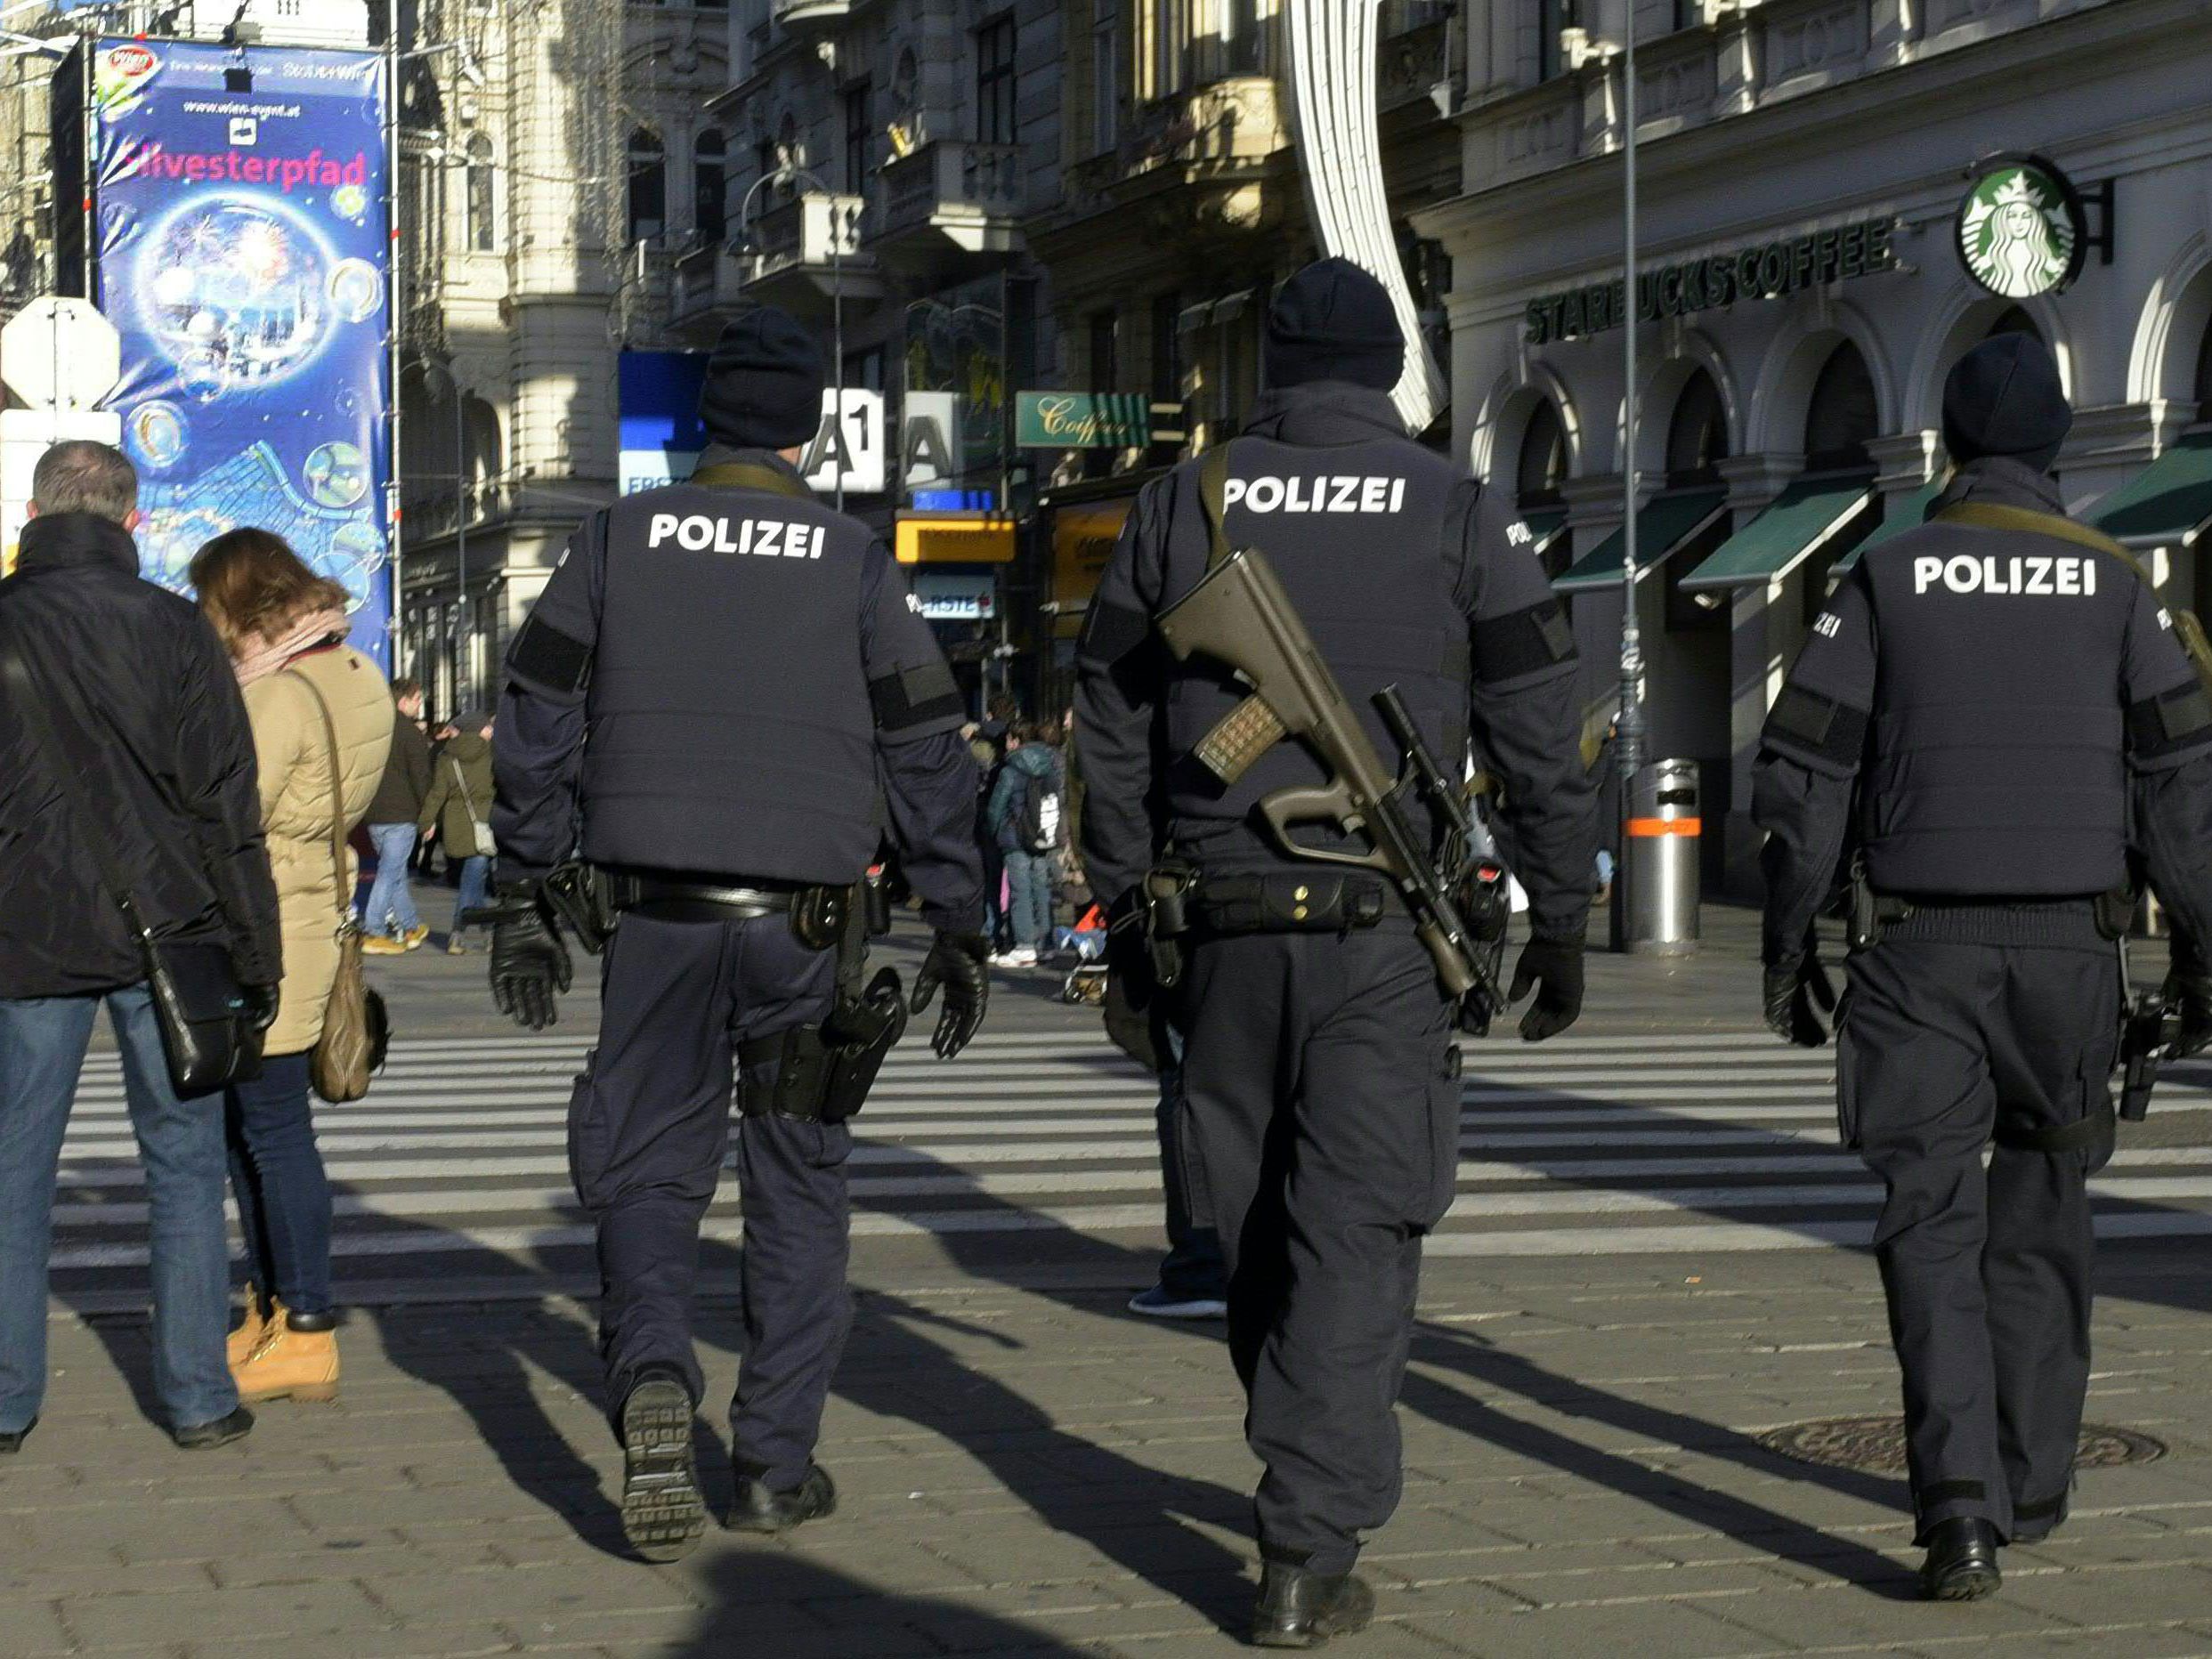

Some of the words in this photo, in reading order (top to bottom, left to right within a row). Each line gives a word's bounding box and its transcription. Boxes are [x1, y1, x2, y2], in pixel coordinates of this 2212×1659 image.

[1525, 256, 1736, 344] STARBUCKS
[1737, 216, 1890, 299] COFFEE
[1223, 475, 1406, 515] POLIZEI
[648, 514, 826, 560] POLIZEI
[1914, 554, 2096, 596] POLIZEI
